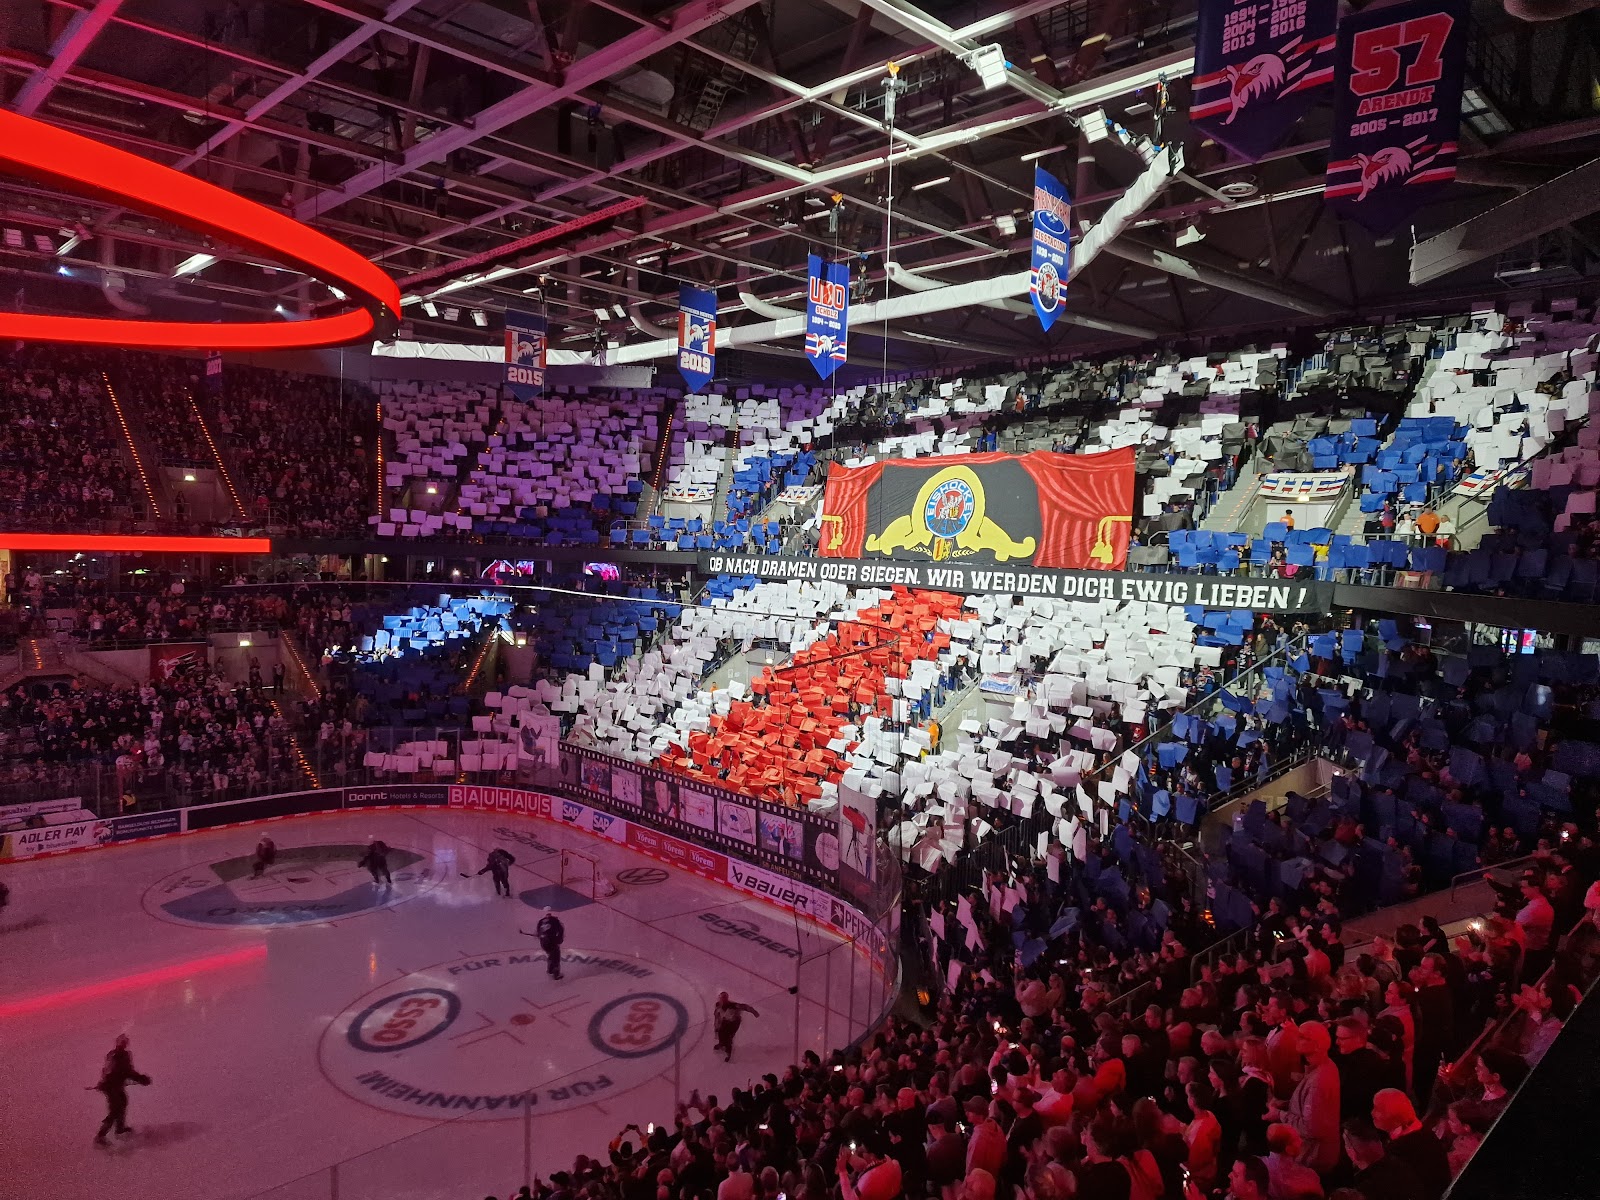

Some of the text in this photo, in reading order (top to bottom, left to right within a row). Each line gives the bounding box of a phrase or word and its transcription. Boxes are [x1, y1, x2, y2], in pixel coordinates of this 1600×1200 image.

[1224, 4, 1257, 27] 1994
[1222, 15, 1306, 55] 2013 2016
[1223, 18, 1257, 41] 2004
[1349, 11, 1455, 96] 57
[1357, 85, 1435, 117] ARENDT
[1350, 118, 1387, 137] 2005
[1402, 108, 1439, 127] 2017
[1034, 228, 1067, 255] EISSTADION
[809, 276, 846, 311] UDO
[815, 305, 839, 320] SCHOLZ
[680, 351, 712, 374] 2019
[507, 367, 544, 386] 2015
[927, 481, 973, 521] EISHOCKEY
[709, 556, 723, 572] OB
[726, 558, 759, 576] NACH
[760, 560, 817, 579] DRAMEN
[820, 563, 857, 582] ODER
[860, 565, 921, 586] SIEGEN.
[926, 568, 964, 589] WIR
[971, 571, 1057, 595] WERDEN
[1063, 575, 1116, 599] DICH
[1121, 578, 1188, 604] EWIG
[1195, 582, 1290, 609] LIEBEN
[348, 791, 388, 802] Dorint
[390, 792, 411, 800] Hotels
[419, 792, 445, 800] Resorts
[451, 788, 551, 813] BAUHAUS
[563, 804, 579, 820] SAP
[593, 814, 610, 831] SAP
[19, 825, 87, 845] ADLER PAY
[636, 831, 657, 847] Yörem
[663, 841, 685, 857] Yörem
[691, 850, 715, 868] Yörem
[698, 912, 801, 958] SCHERER
[447, 957, 501, 976] FÜR
[547, 1074, 616, 1101] FÜR
